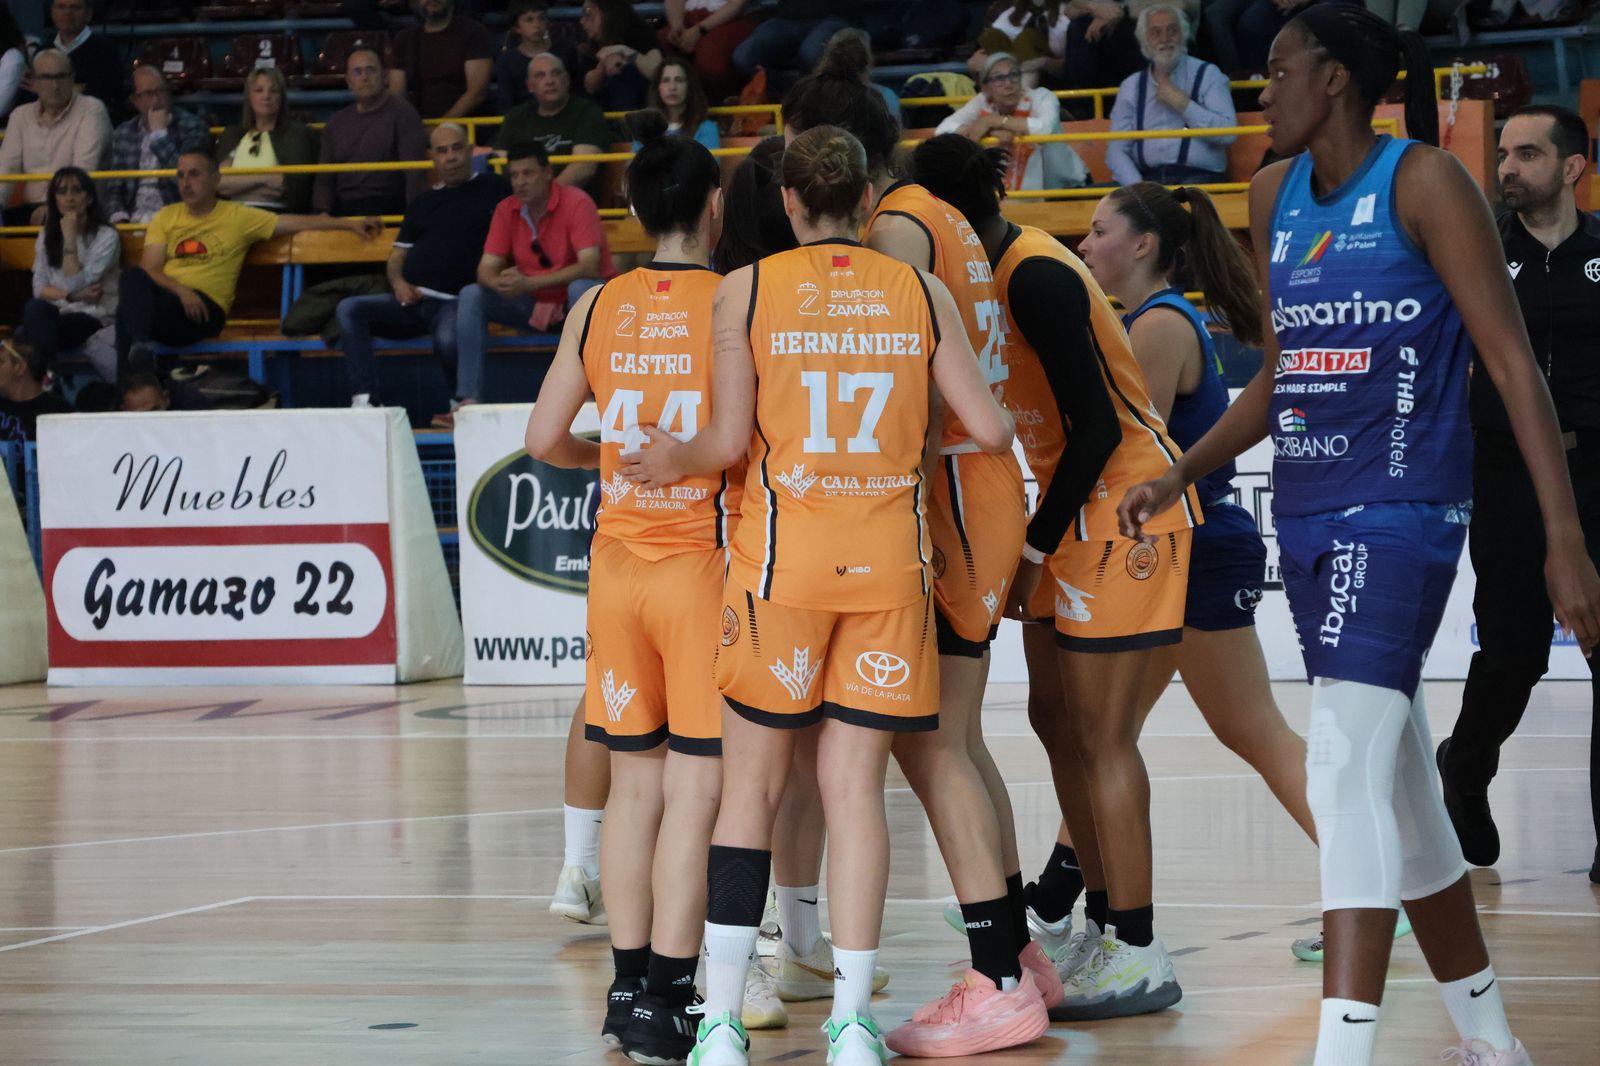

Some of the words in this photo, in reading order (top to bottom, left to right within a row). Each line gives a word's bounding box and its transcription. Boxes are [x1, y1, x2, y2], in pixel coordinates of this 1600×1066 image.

[259, 39, 272, 57] 2
[827, 303, 890, 317] ZAMORA
[640, 325, 689, 339] ZAMORA
[770, 327, 922, 356] HERNÁNDEZ
[610, 352, 692, 376] CASTRO
[1286, 383, 1307, 393] MADE
[1307, 382, 1348, 393] SIMPLE
[1397, 371, 1416, 414] THB
[600, 388, 702, 457] 44
[801, 370, 894, 454] 17
[1389, 416, 1411, 479] hotels
[112, 448, 317, 516] Muebles
[634, 485, 665, 500] CAJA
[670, 486, 709, 501] RURAL
[820, 475, 860, 490] CAJA
[865, 474, 917, 490] RURAL
[503, 471, 596, 549] Paul
[635, 499, 647, 508] DE
[648, 499, 687, 510] ZAMORA
[84, 557, 277, 631] Gamazo
[295, 560, 356, 617] 22
[1319, 539, 1355, 648] ibacar
[1353, 543, 1369, 589] GROUP
[474, 636, 587, 669] www.pa
[861, 686, 873, 696] DE
[874, 689, 885, 698] LA
[886, 691, 912, 702] PLATA
